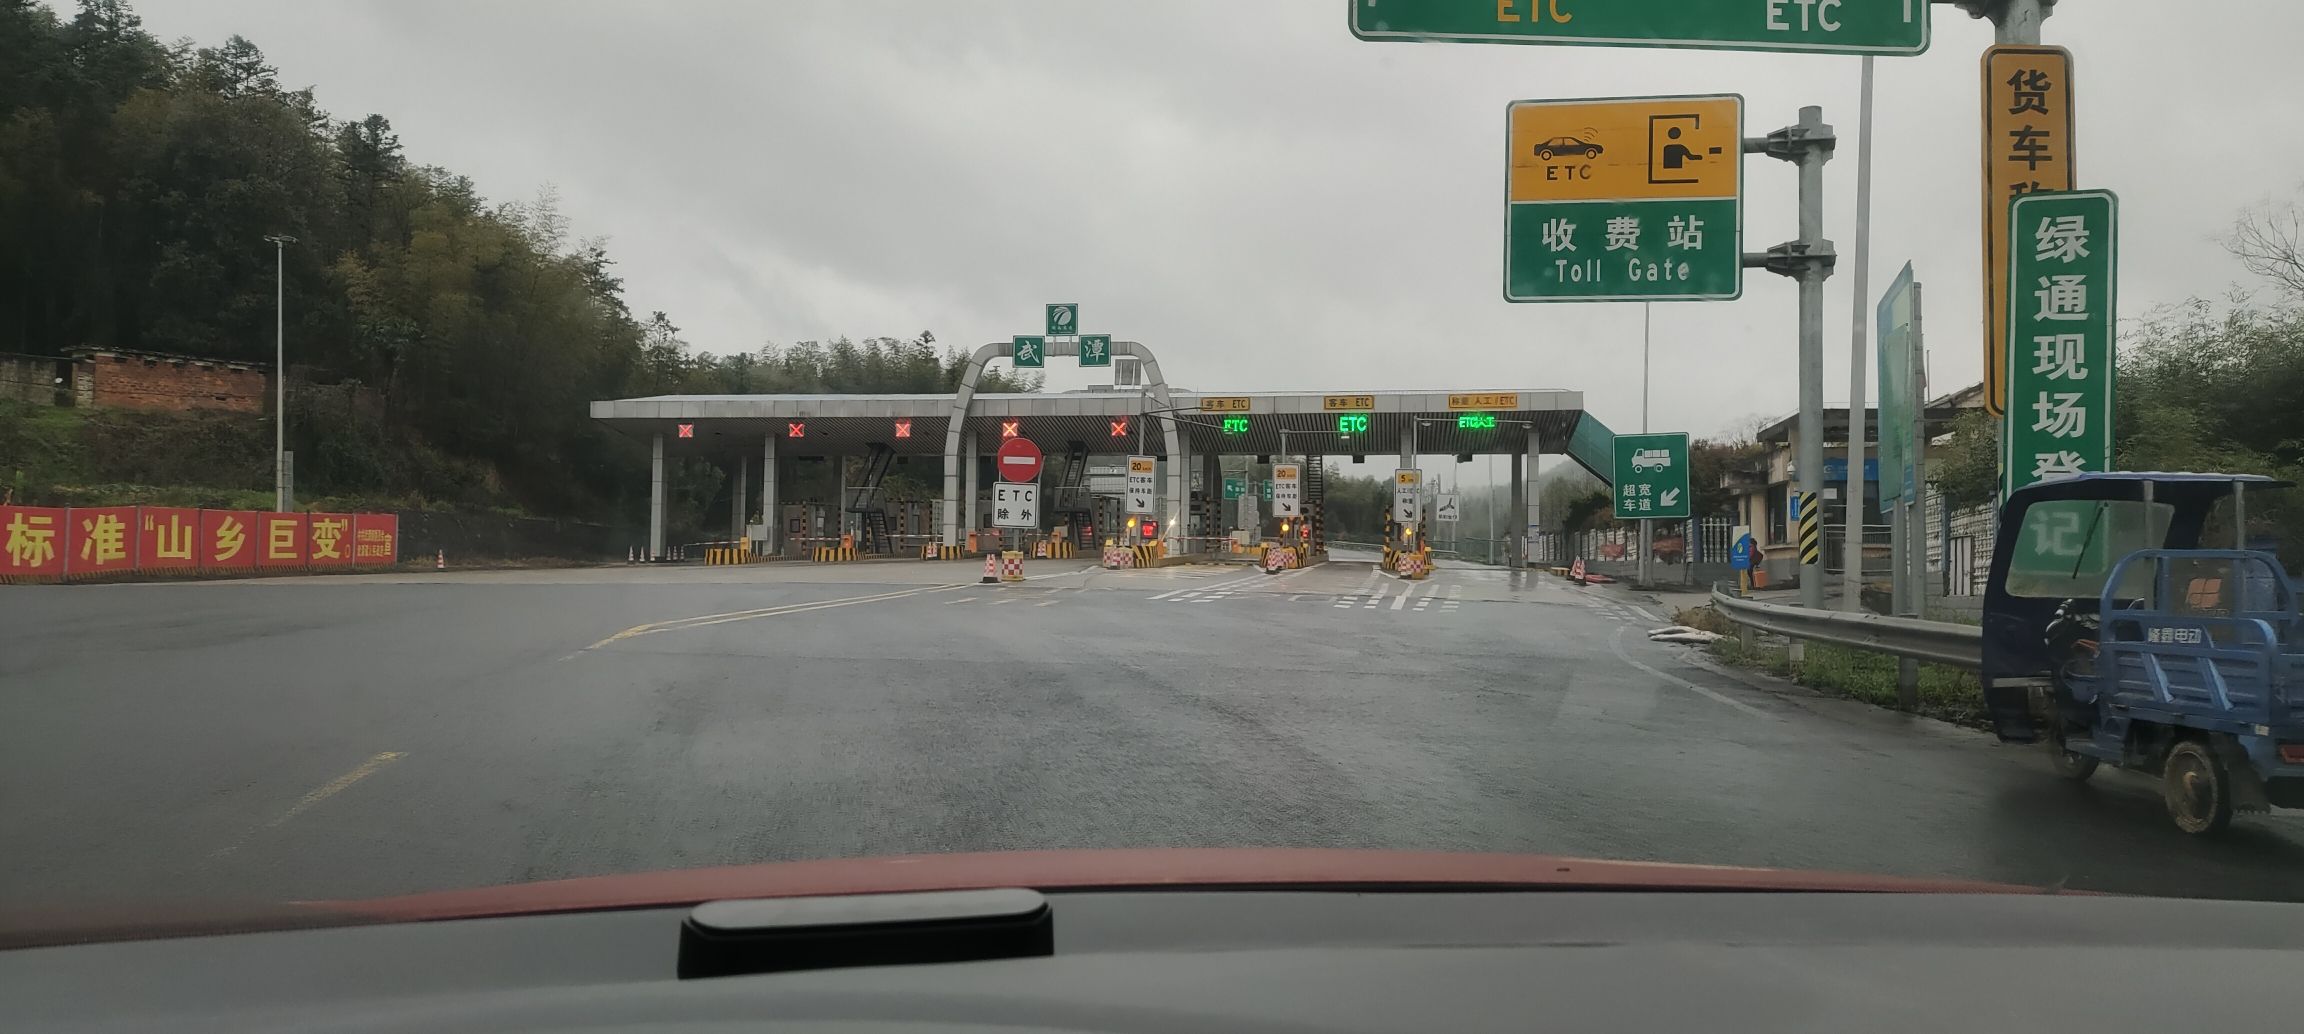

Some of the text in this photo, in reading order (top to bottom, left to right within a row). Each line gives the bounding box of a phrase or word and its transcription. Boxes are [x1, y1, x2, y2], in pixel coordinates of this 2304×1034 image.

[1766, 0, 1842, 32] ETC
[2006, 69, 2053, 195] 货车
[1546, 166, 1593, 181] ETC
[1541, 215, 1704, 252] 收费站
[1555, 257, 1690, 284] Toll Gate
[1355, 397, 1370, 407] ETC
[1224, 419, 1248, 432] ETC
[1339, 416, 1367, 432] ETC
[1132, 462, 1142, 471] 20
[998, 489, 1033, 502] ETC
[1622, 483, 1652, 497] 超宽
[1622, 498, 1652, 511] 车道
[997, 507, 1033, 521] 除外
